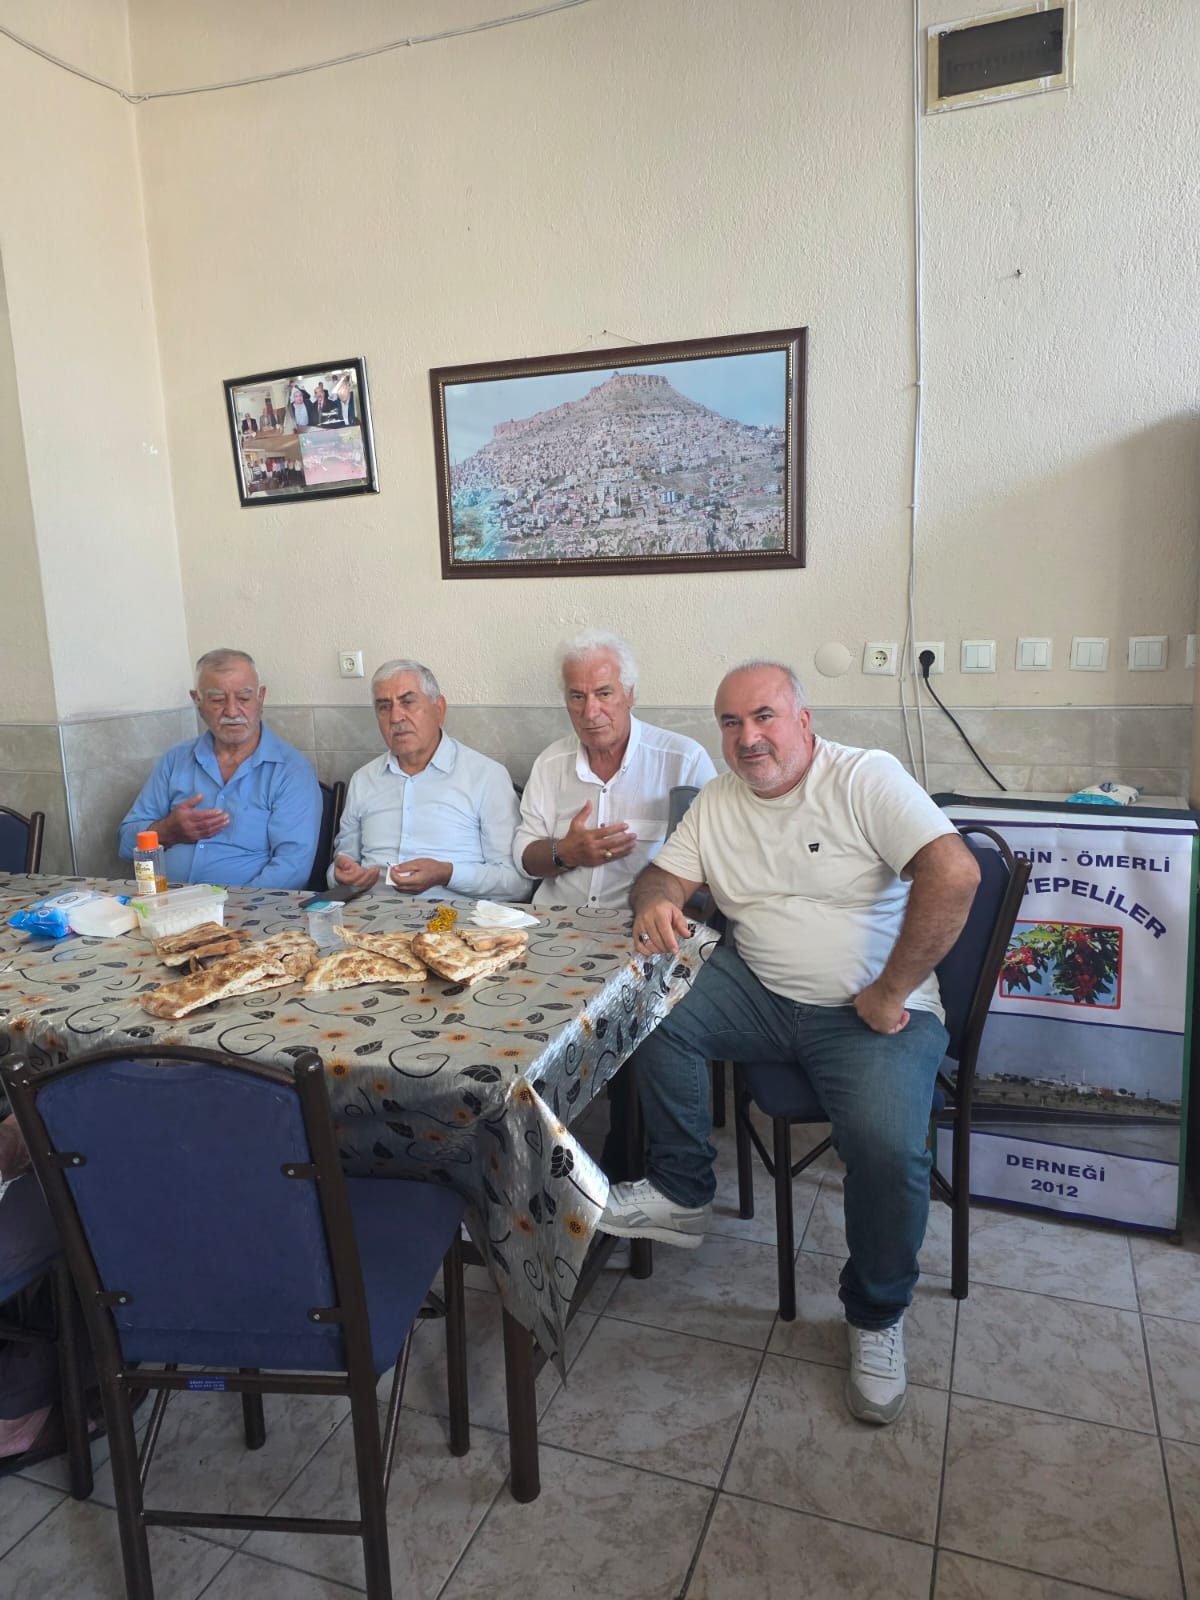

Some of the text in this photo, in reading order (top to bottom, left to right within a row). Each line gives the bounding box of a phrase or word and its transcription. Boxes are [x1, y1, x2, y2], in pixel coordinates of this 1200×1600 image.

[999, 847, 1052, 864] DİN
[1077, 850, 1170, 873] ÖMERLİ
[1006, 1153, 1105, 1182] DERNEĞİ
[1031, 1179, 1079, 1198] 2012
